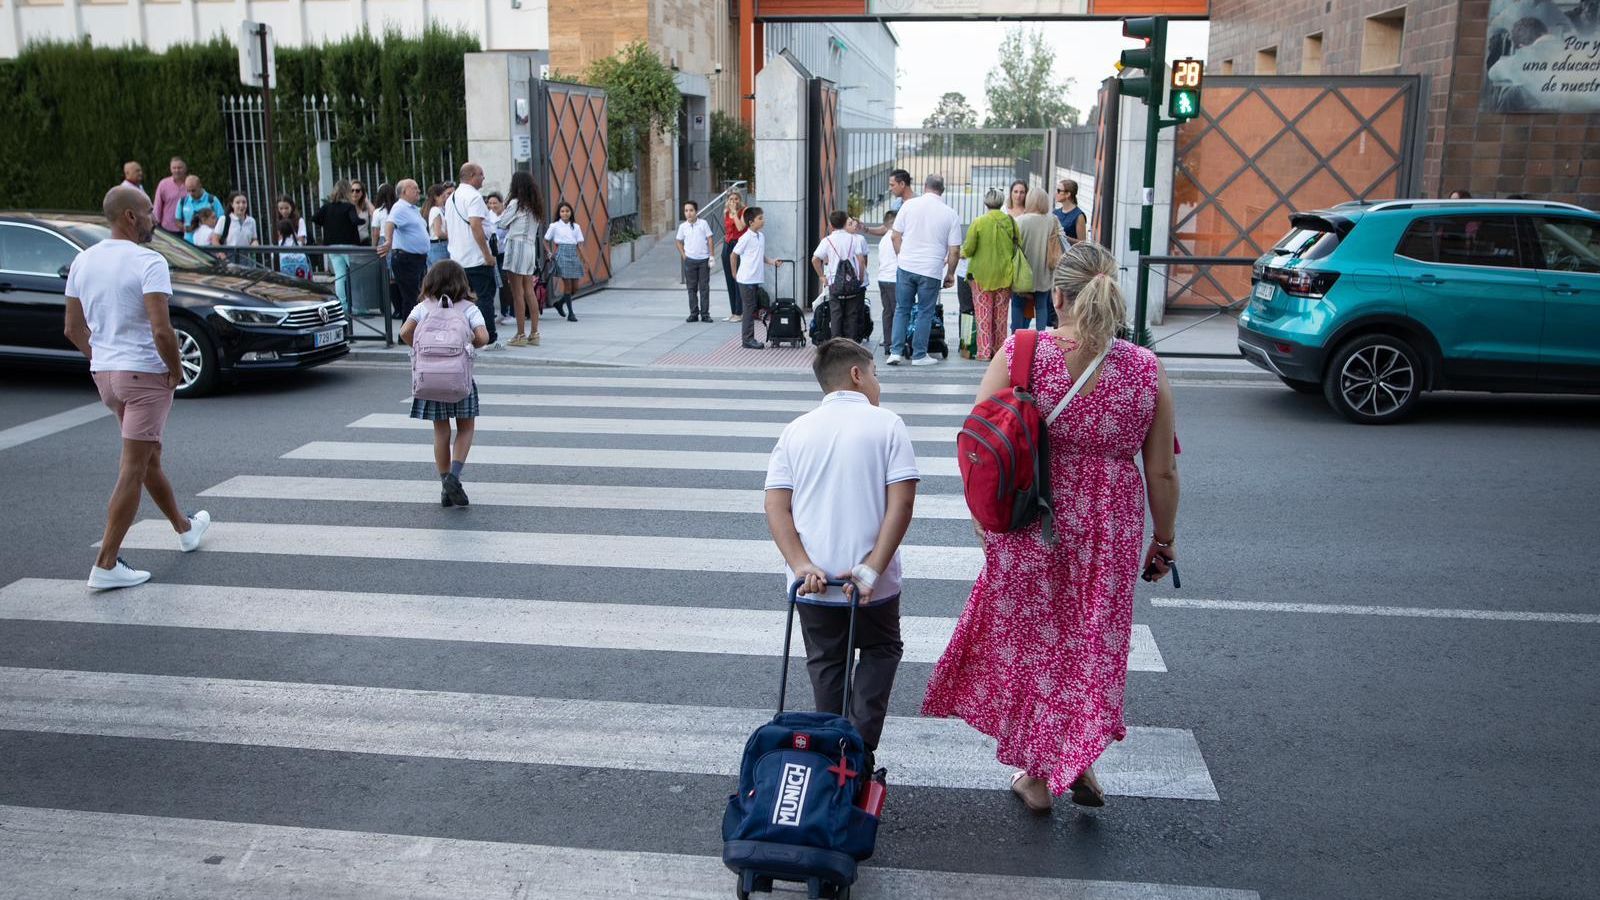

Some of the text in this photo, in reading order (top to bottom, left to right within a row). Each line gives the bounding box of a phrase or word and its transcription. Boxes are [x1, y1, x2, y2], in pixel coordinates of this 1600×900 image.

[1564, 36, 1590, 50] Por
[1175, 62, 1200, 86] 28
[1522, 61, 1548, 71] una
[1541, 75, 1557, 92] de
[777, 763, 806, 826] MUNICH
